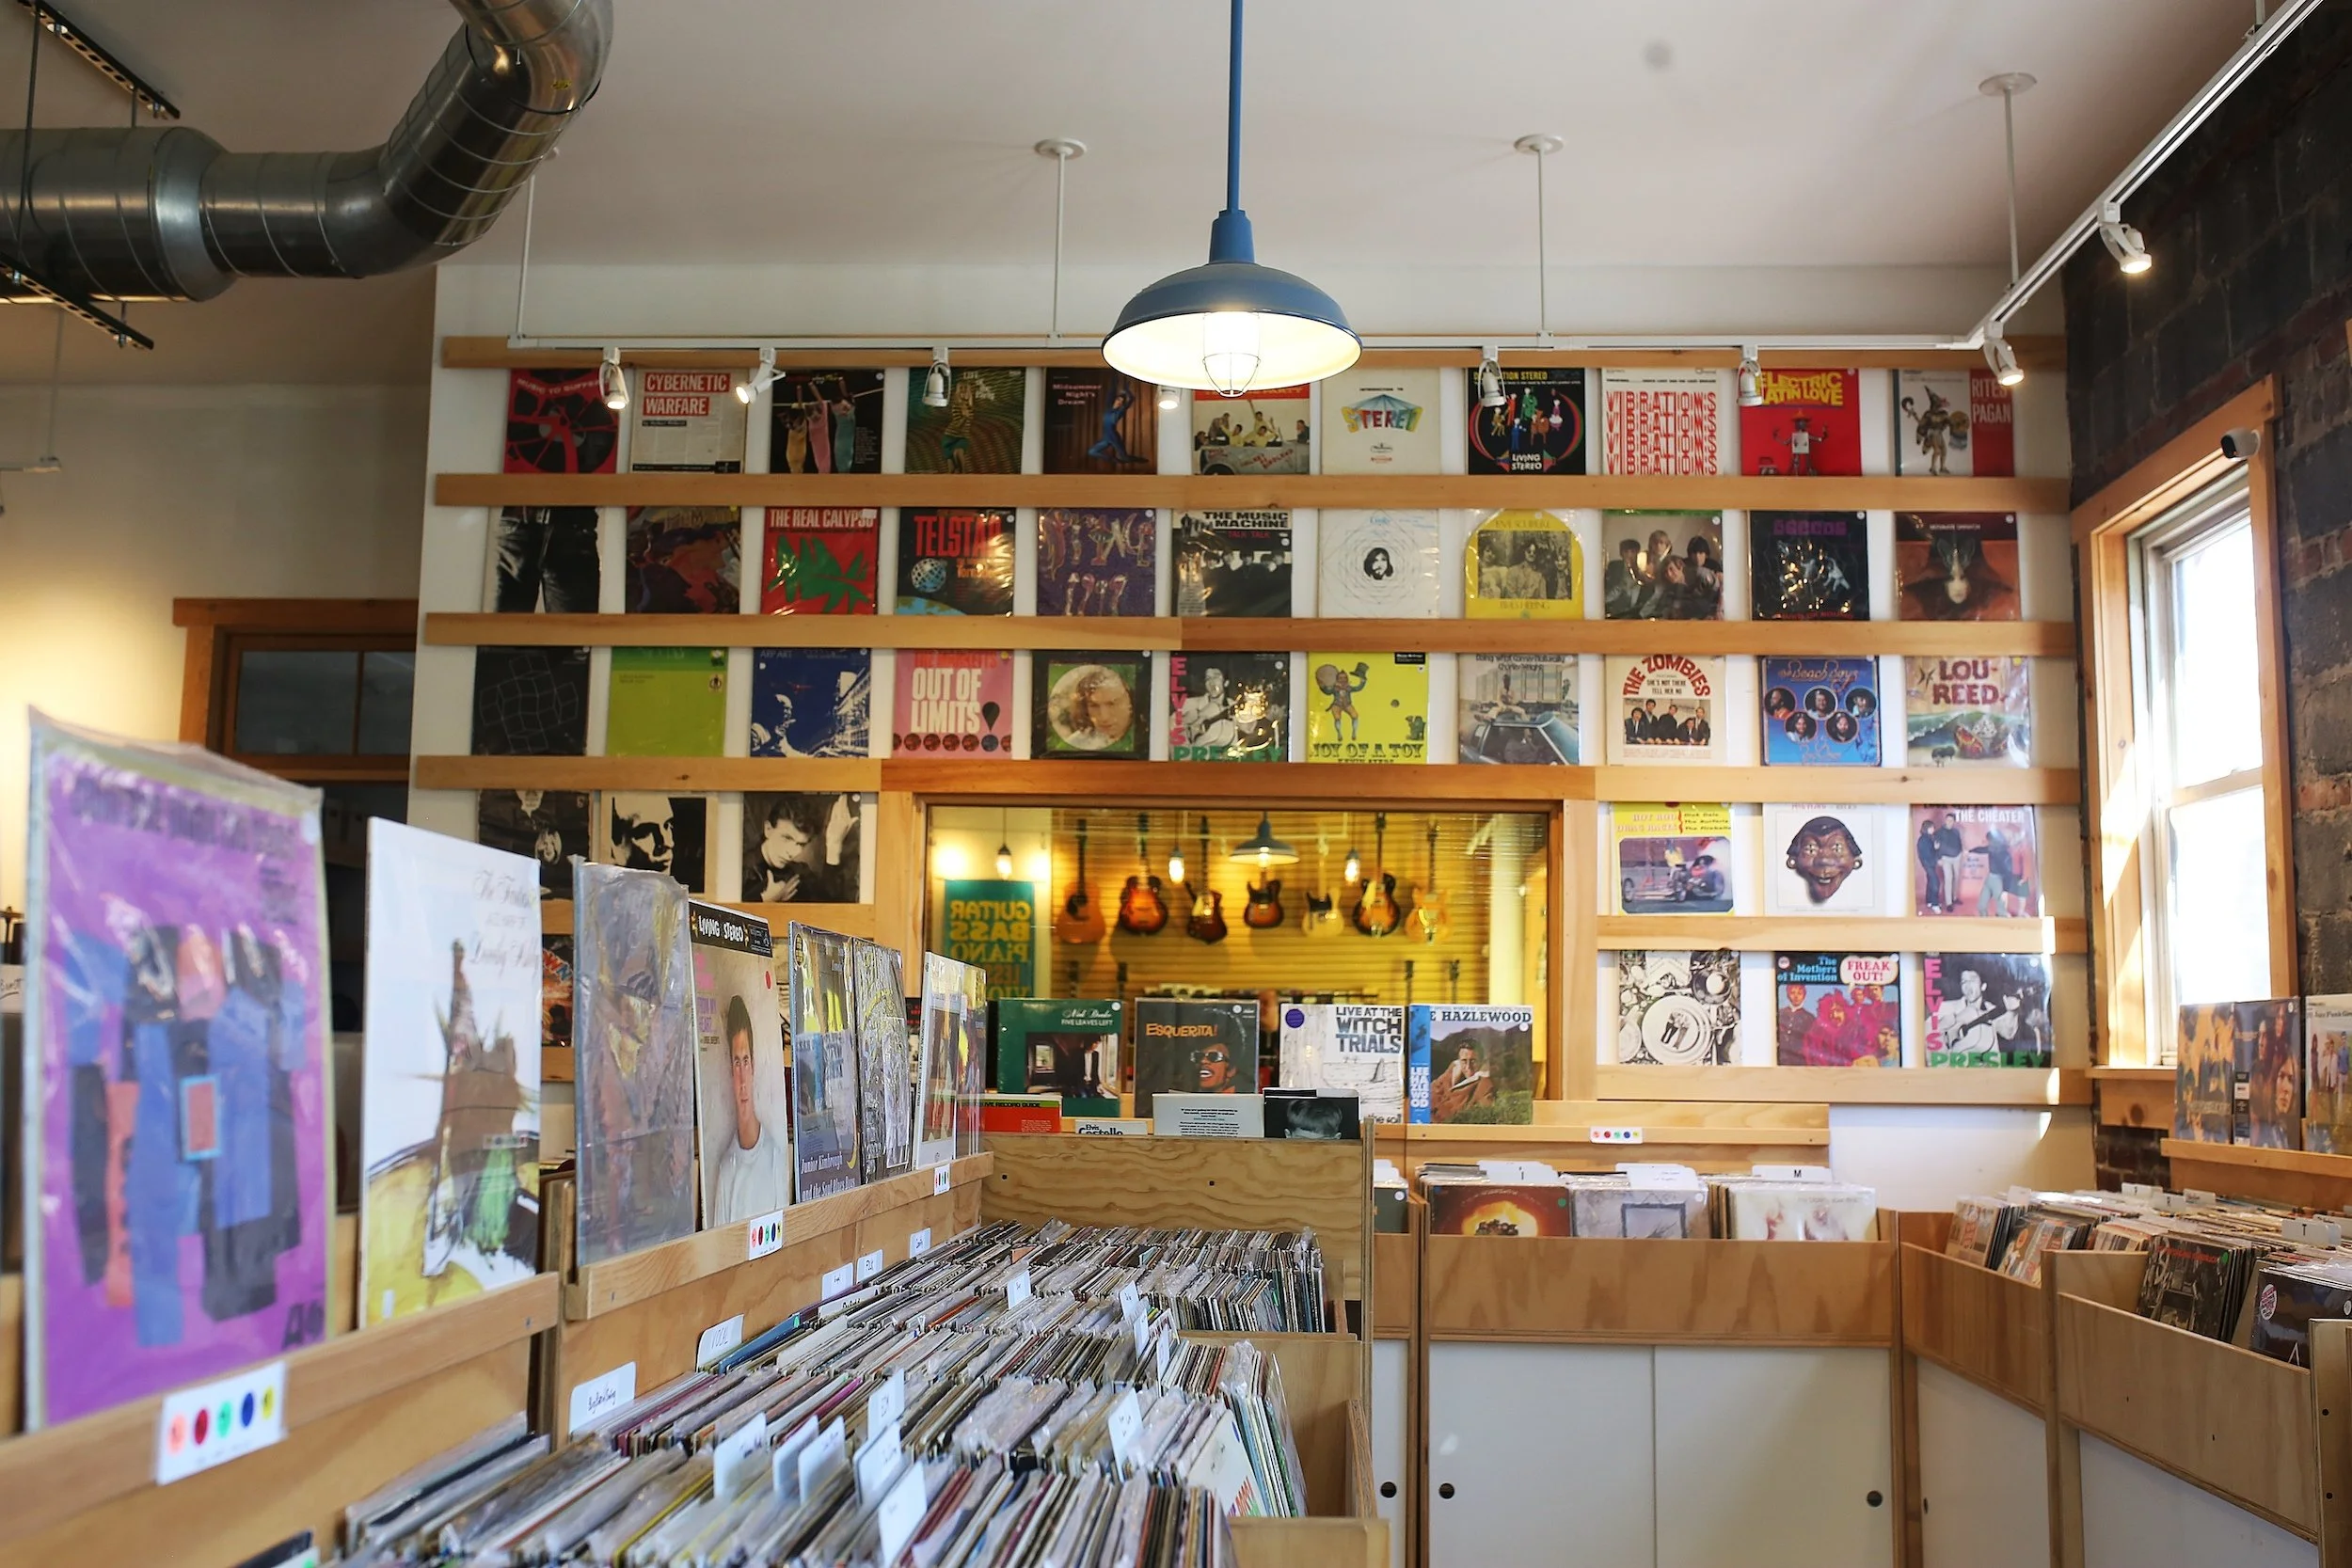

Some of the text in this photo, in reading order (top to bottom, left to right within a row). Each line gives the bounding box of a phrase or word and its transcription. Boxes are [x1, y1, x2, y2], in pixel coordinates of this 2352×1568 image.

[645, 374, 727, 391] CYBERNETIC
[1520, 371, 1549, 381] STEREO
[1756, 371, 1843, 389] ELECTRIC
[1971, 378, 2009, 397] RITES
[1802, 387, 1844, 406] LOVE
[644, 398, 707, 415] WARFARE
[1972, 404, 2011, 423] PAGAN
[1512, 453, 1541, 463] LIVING
[1511, 462, 1543, 471] STEREO
[770, 509, 790, 528] THE
[792, 509, 819, 528] REAL
[1202, 512, 1289, 520] THE MUSIC
[1215, 519, 1289, 528] MACHINE
[1623, 653, 1711, 697] THE ZOMBIES
[1939, 659, 1990, 680] LOU
[912, 668, 982, 701] OUT OF
[1169, 656, 1187, 745] ELVIS
[1931, 683, 1999, 705] REED
[1312, 743, 1423, 758] JOY OF A TOY
[1955, 810, 2025, 824] THE CHEATER
[698, 914, 721, 939] LIVING
[723, 922, 744, 942] STEREO
[1818, 956, 1837, 966] The
[1847, 959, 1890, 973] FREAK
[1796, 964, 1836, 974] Mothers
[1776, 972, 1837, 983] of Invention
[1852, 972, 1883, 983] OUT!
[1336, 1006, 1402, 1018] LIVE AT THE
[1924, 958, 1945, 1051] ELVIS
[1060, 1019, 1114, 1027] FIVE LEAVES LEFT
[1441, 1010, 1532, 1022] HAZLEWOOD
[1145, 1022, 1218, 1037] ESQUERITA!
[1336, 1017, 1402, 1035] WITCH
[1336, 1034, 1402, 1053] TRIALS
[1930, 1052, 2045, 1068] PRESLEY
[1410, 1066, 1430, 1075] LEE
[1085, 1123, 1100, 1132] Elvis
[801, 1150, 843, 1175] Junior Kimbrough
[1793, 1169, 1803, 1179] M
[802, 1183, 812, 1202] and
[813, 1182, 821, 1199] the
[821, 1180, 833, 1197] Soul
[833, 1178, 845, 1195] Blues
[2301, 1223, 2308, 1236] T
